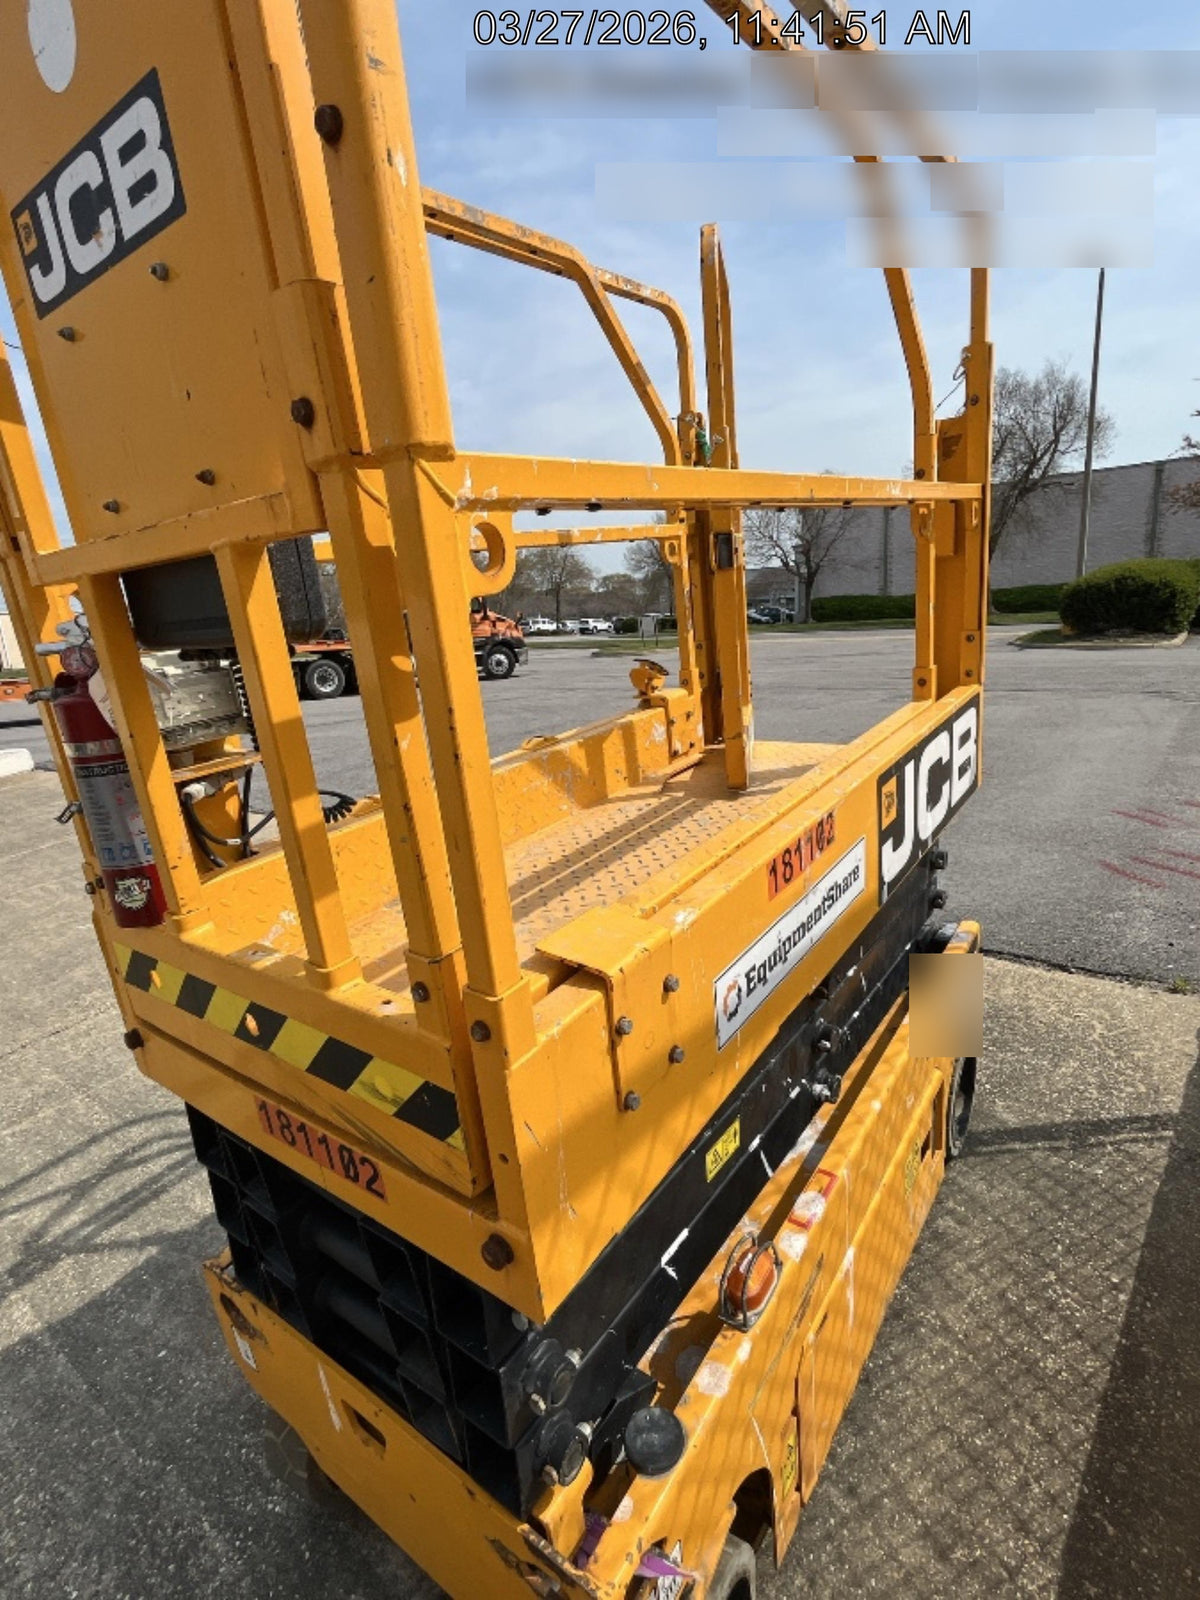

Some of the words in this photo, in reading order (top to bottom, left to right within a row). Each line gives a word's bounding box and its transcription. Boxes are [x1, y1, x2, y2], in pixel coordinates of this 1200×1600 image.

[30, 96, 175, 303] JCB
[769, 811, 835, 894] 181102
[882, 706, 978, 883] JCB
[745, 864, 861, 998] EquipmentShare
[259, 1100, 386, 1201] 181102
